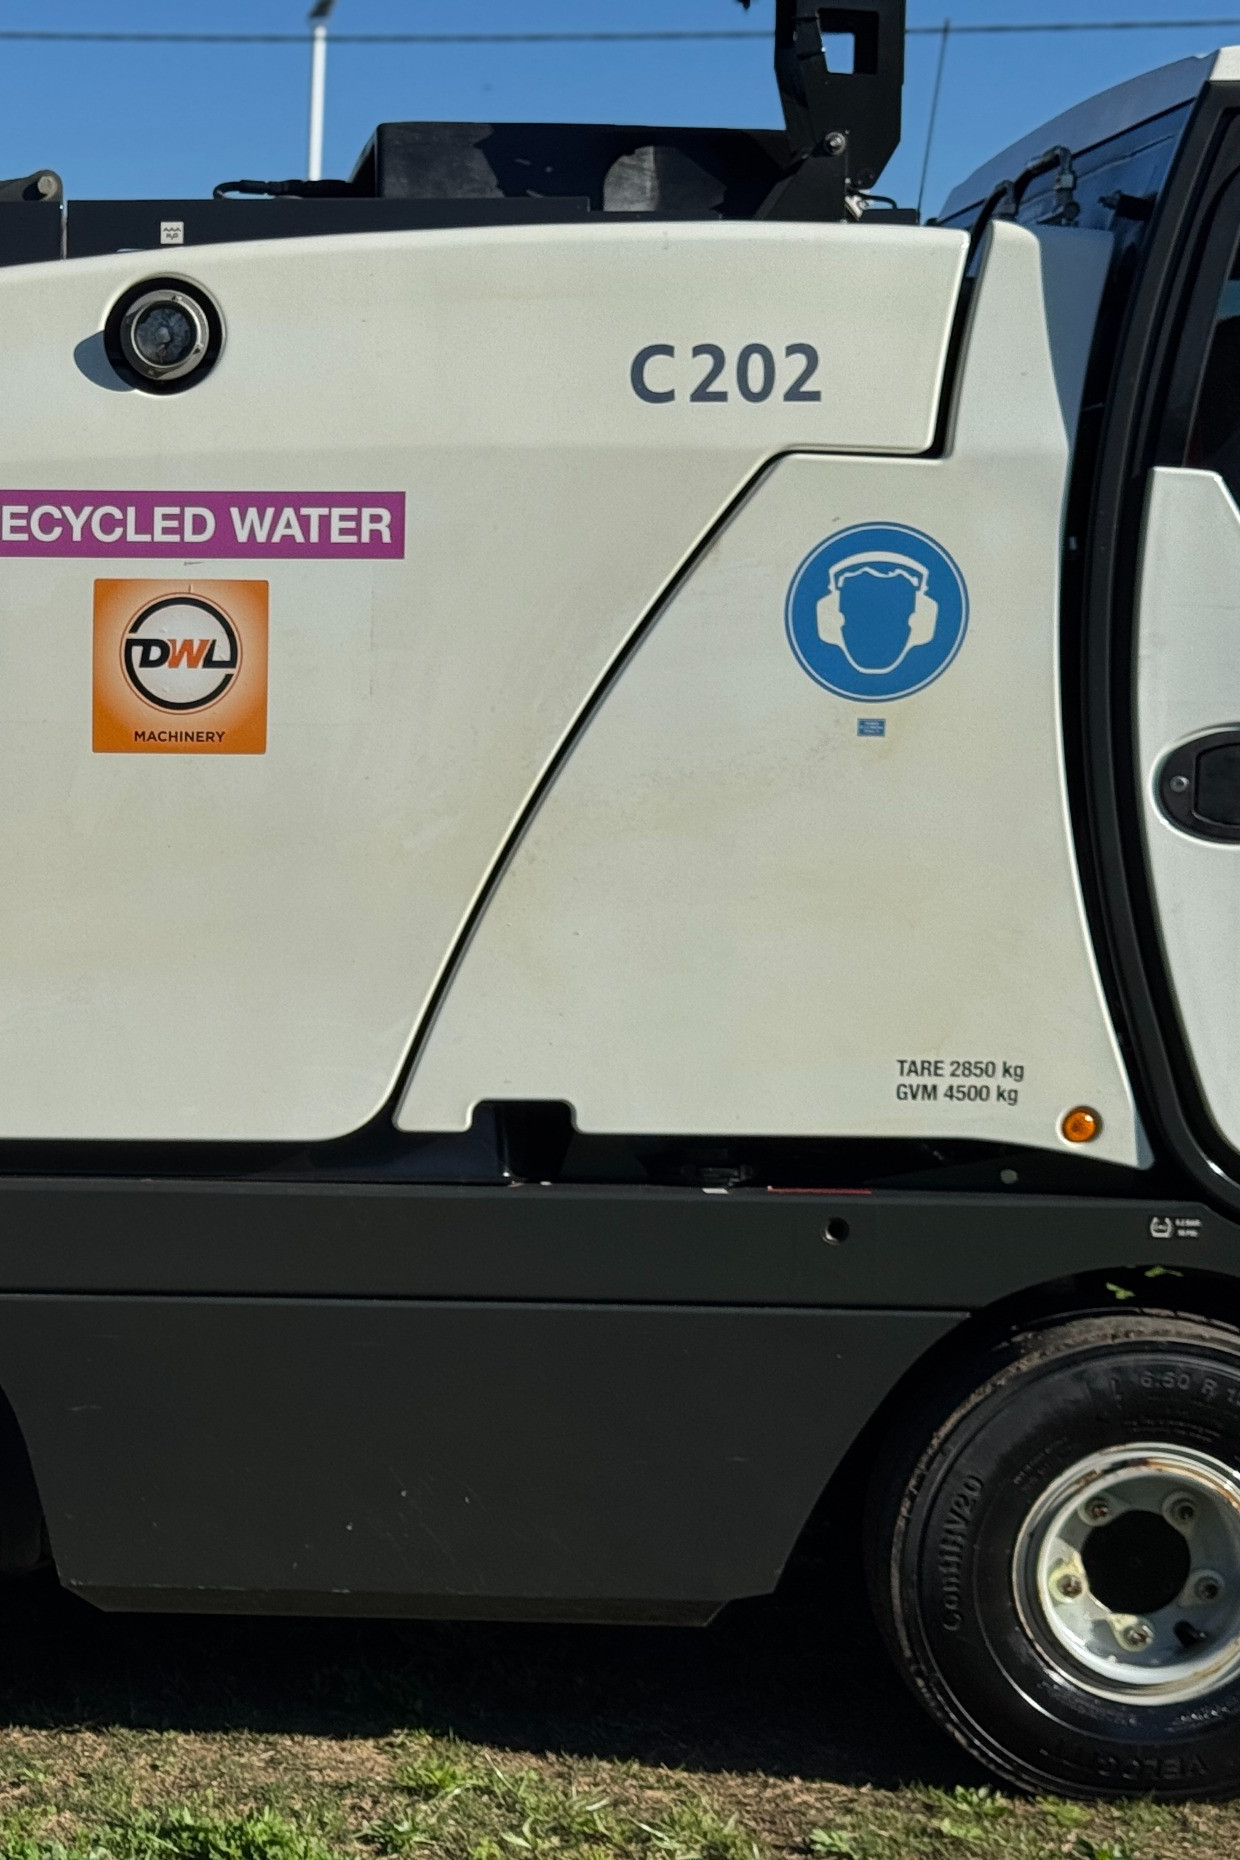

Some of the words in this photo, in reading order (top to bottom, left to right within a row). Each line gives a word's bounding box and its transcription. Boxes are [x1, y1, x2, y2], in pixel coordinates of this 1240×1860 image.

[230, 507, 392, 544] WATER
[124, 638, 237, 669] DWL
[134, 730, 226, 743] MACHINERY
[896, 1059, 945, 1078] TARE
[949, 1060, 996, 1078] 2850
[1002, 1061, 1025, 1083] kg
[896, 1083, 938, 1101] GVM
[943, 1084, 991, 1102] 4500
[996, 1085, 1019, 1106] kg
